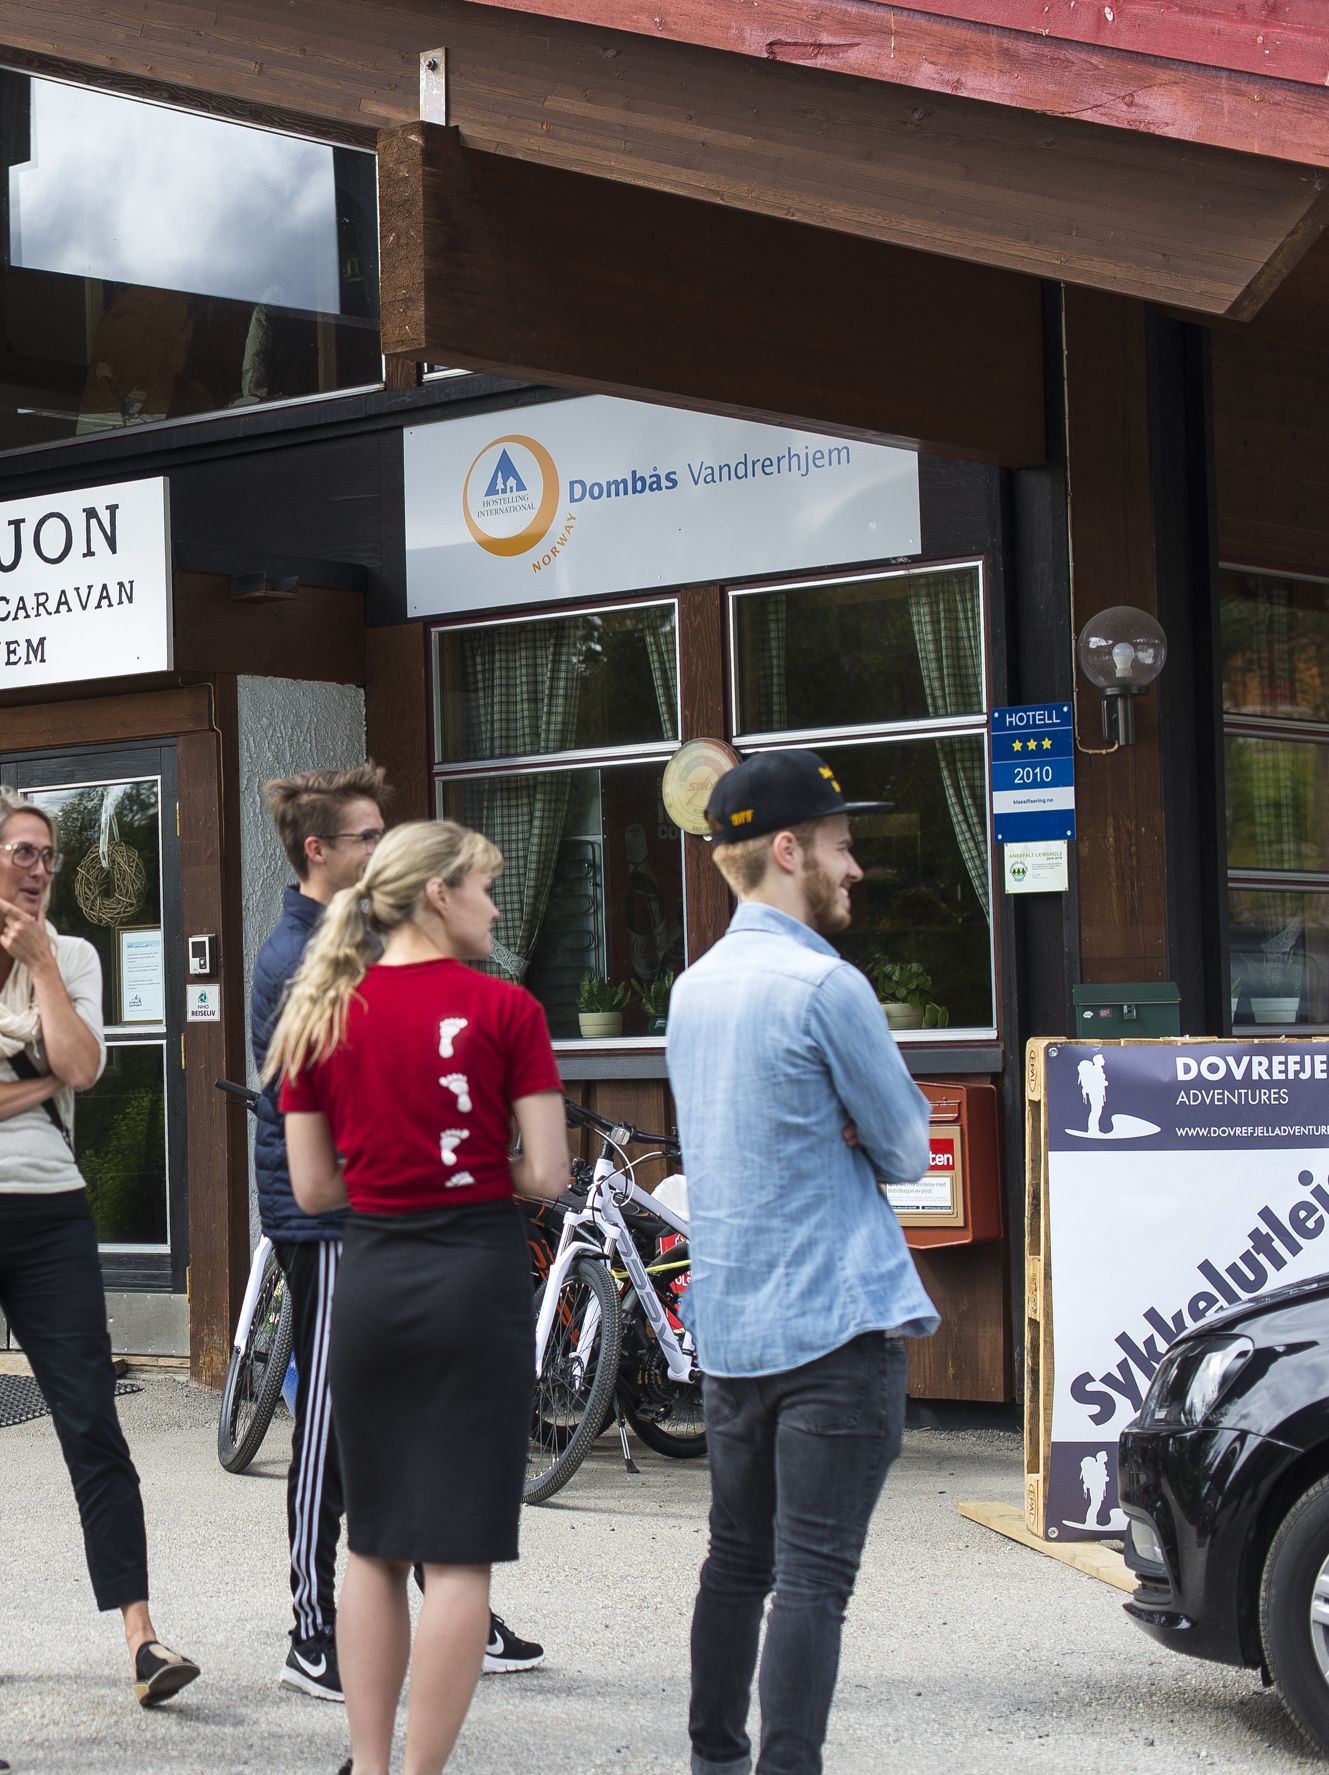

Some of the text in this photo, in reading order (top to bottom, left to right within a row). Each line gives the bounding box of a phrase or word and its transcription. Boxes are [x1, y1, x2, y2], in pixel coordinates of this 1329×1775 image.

[568, 444, 852, 505] Dombås Vandrerhjem
[482, 493, 529, 508] HOSTELLING
[477, 502, 536, 519] INTERNATIONAL
[532, 512, 577, 573] NORWAY
[1006, 709, 1061, 727] HOTELL
[1013, 765, 1052, 784] 2010
[191, 1009, 216, 1017] REISELIV
[1175, 1054, 1328, 1081] DOVREFJE
[1175, 1088, 1289, 1106] ADVENTURES
[929, 1150, 953, 1166] ten
[1070, 1169, 1329, 1427] Sykkelutlei
